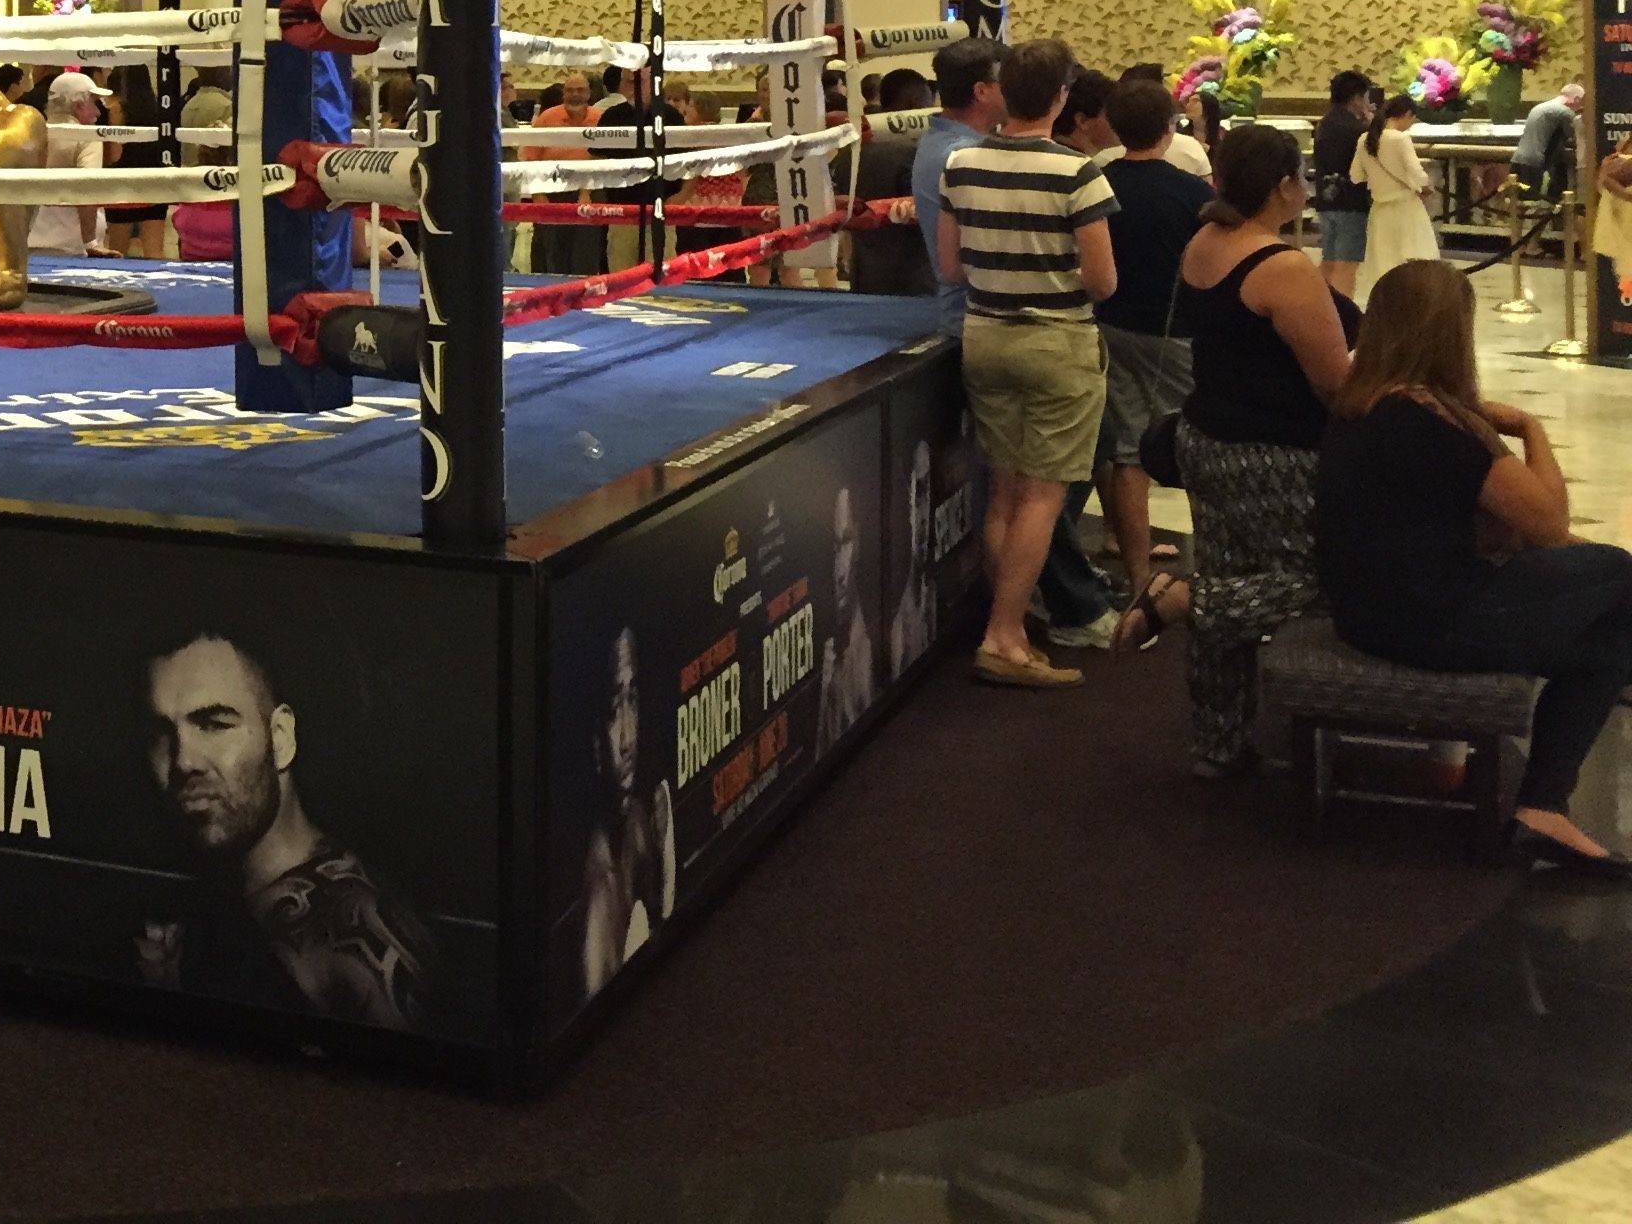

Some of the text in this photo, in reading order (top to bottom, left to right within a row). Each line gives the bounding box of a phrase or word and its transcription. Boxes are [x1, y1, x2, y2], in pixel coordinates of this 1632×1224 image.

[188, 10, 240, 34] Coro
[341, 0, 418, 34] Corona
[871, 23, 949, 49] Corona
[582, 127, 629, 141] Corona
[887, 112, 932, 133] Cor
[204, 164, 285, 193] Cona
[324, 147, 400, 183] Corona
[94, 319, 173, 340] Corona
[762, 602, 814, 711] PORTER
[677, 661, 741, 790] BRONER
